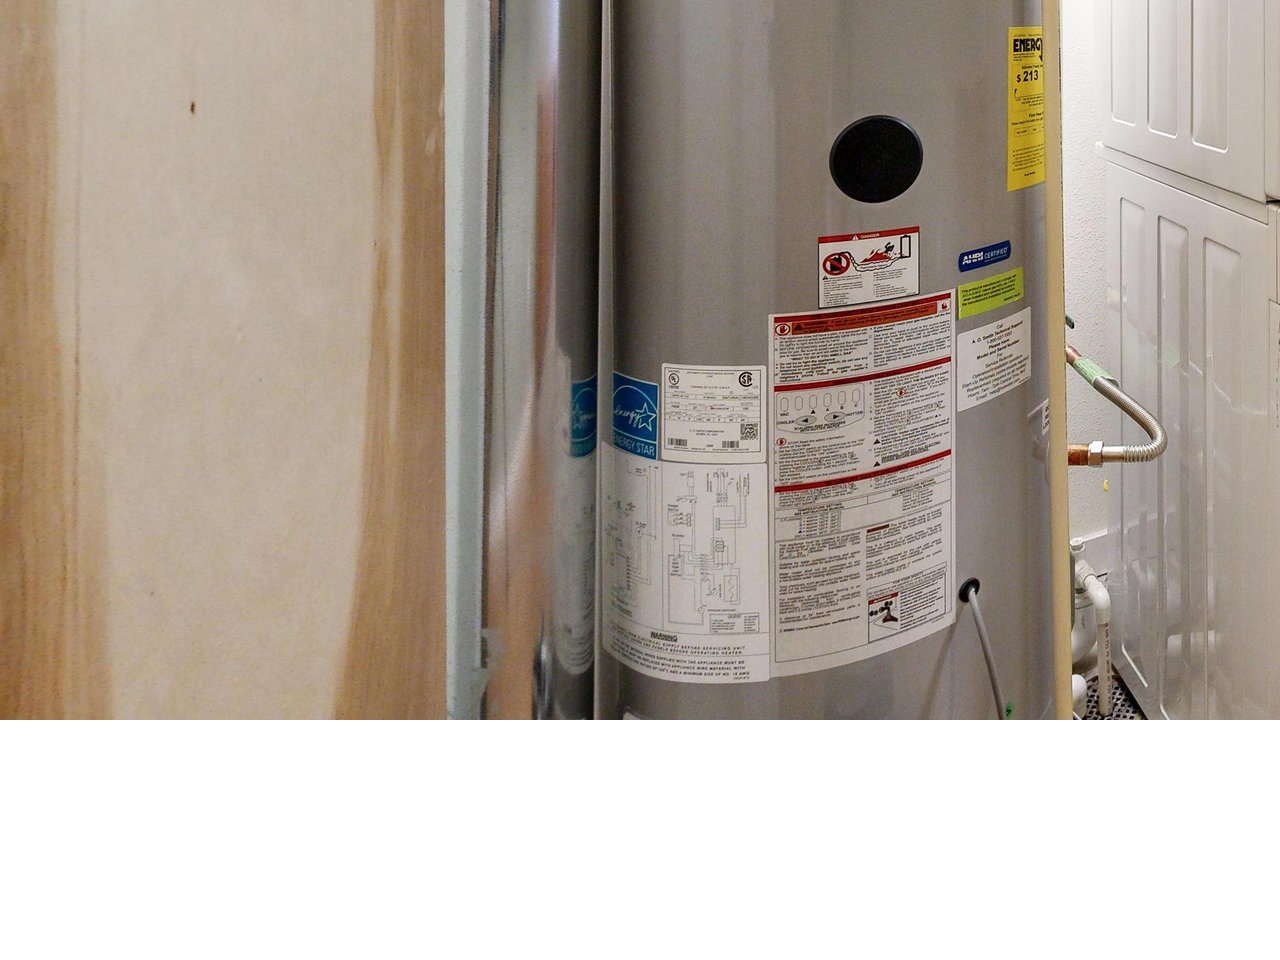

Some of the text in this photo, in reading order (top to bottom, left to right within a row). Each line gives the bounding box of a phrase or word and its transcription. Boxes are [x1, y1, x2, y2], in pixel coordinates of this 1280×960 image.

[962, 247, 1008, 265] AHRI CERTIFIED
[636, 442, 655, 456] STAR
[650, 632, 677, 642] WARNING
